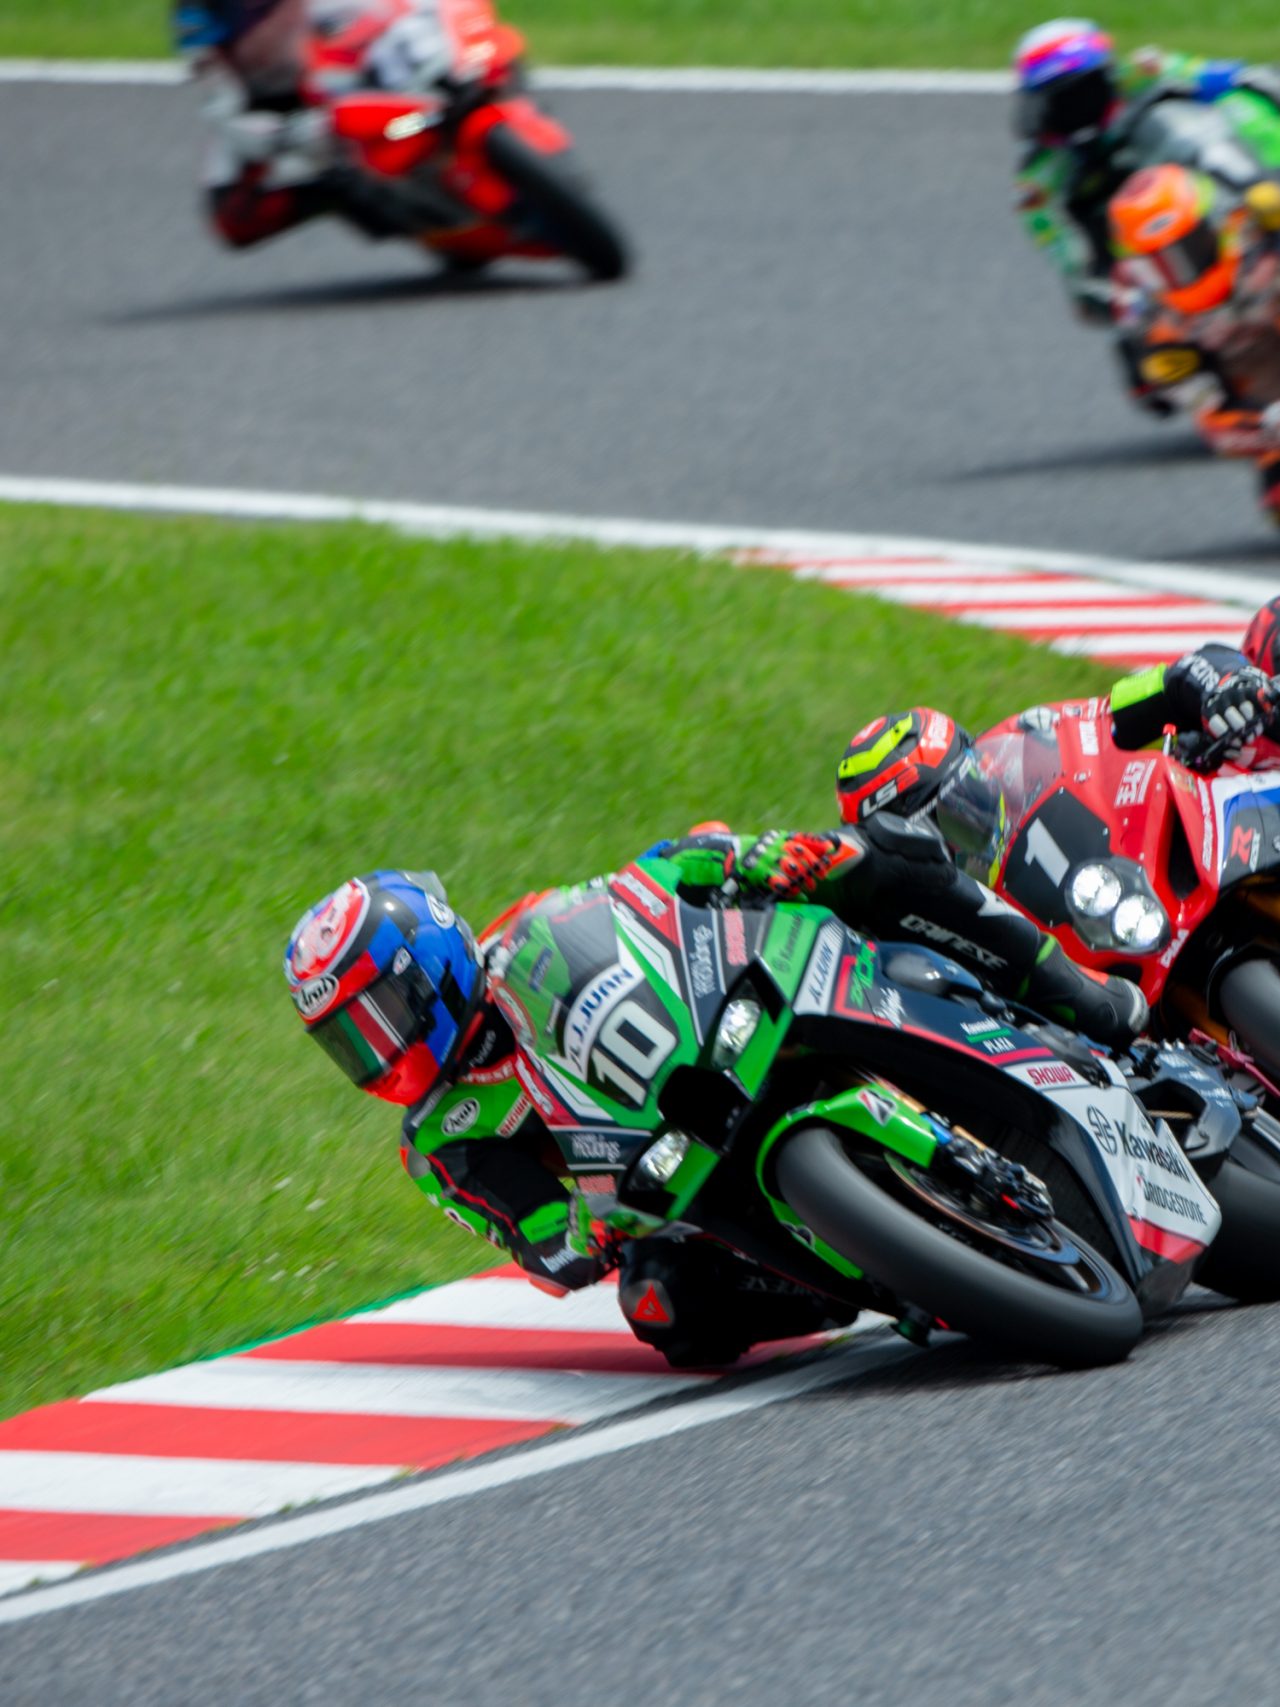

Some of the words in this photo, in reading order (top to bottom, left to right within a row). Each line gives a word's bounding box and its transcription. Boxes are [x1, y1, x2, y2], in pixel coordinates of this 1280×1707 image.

[863, 764, 920, 817] LS2
[1024, 817, 1070, 888] 1
[592, 1000, 677, 1107] 10
[1026, 1065, 1077, 1086] SHOWA
[1114, 1119, 1191, 1183] Kawasaki
[1142, 1179, 1208, 1226] BRIDGESTONE
